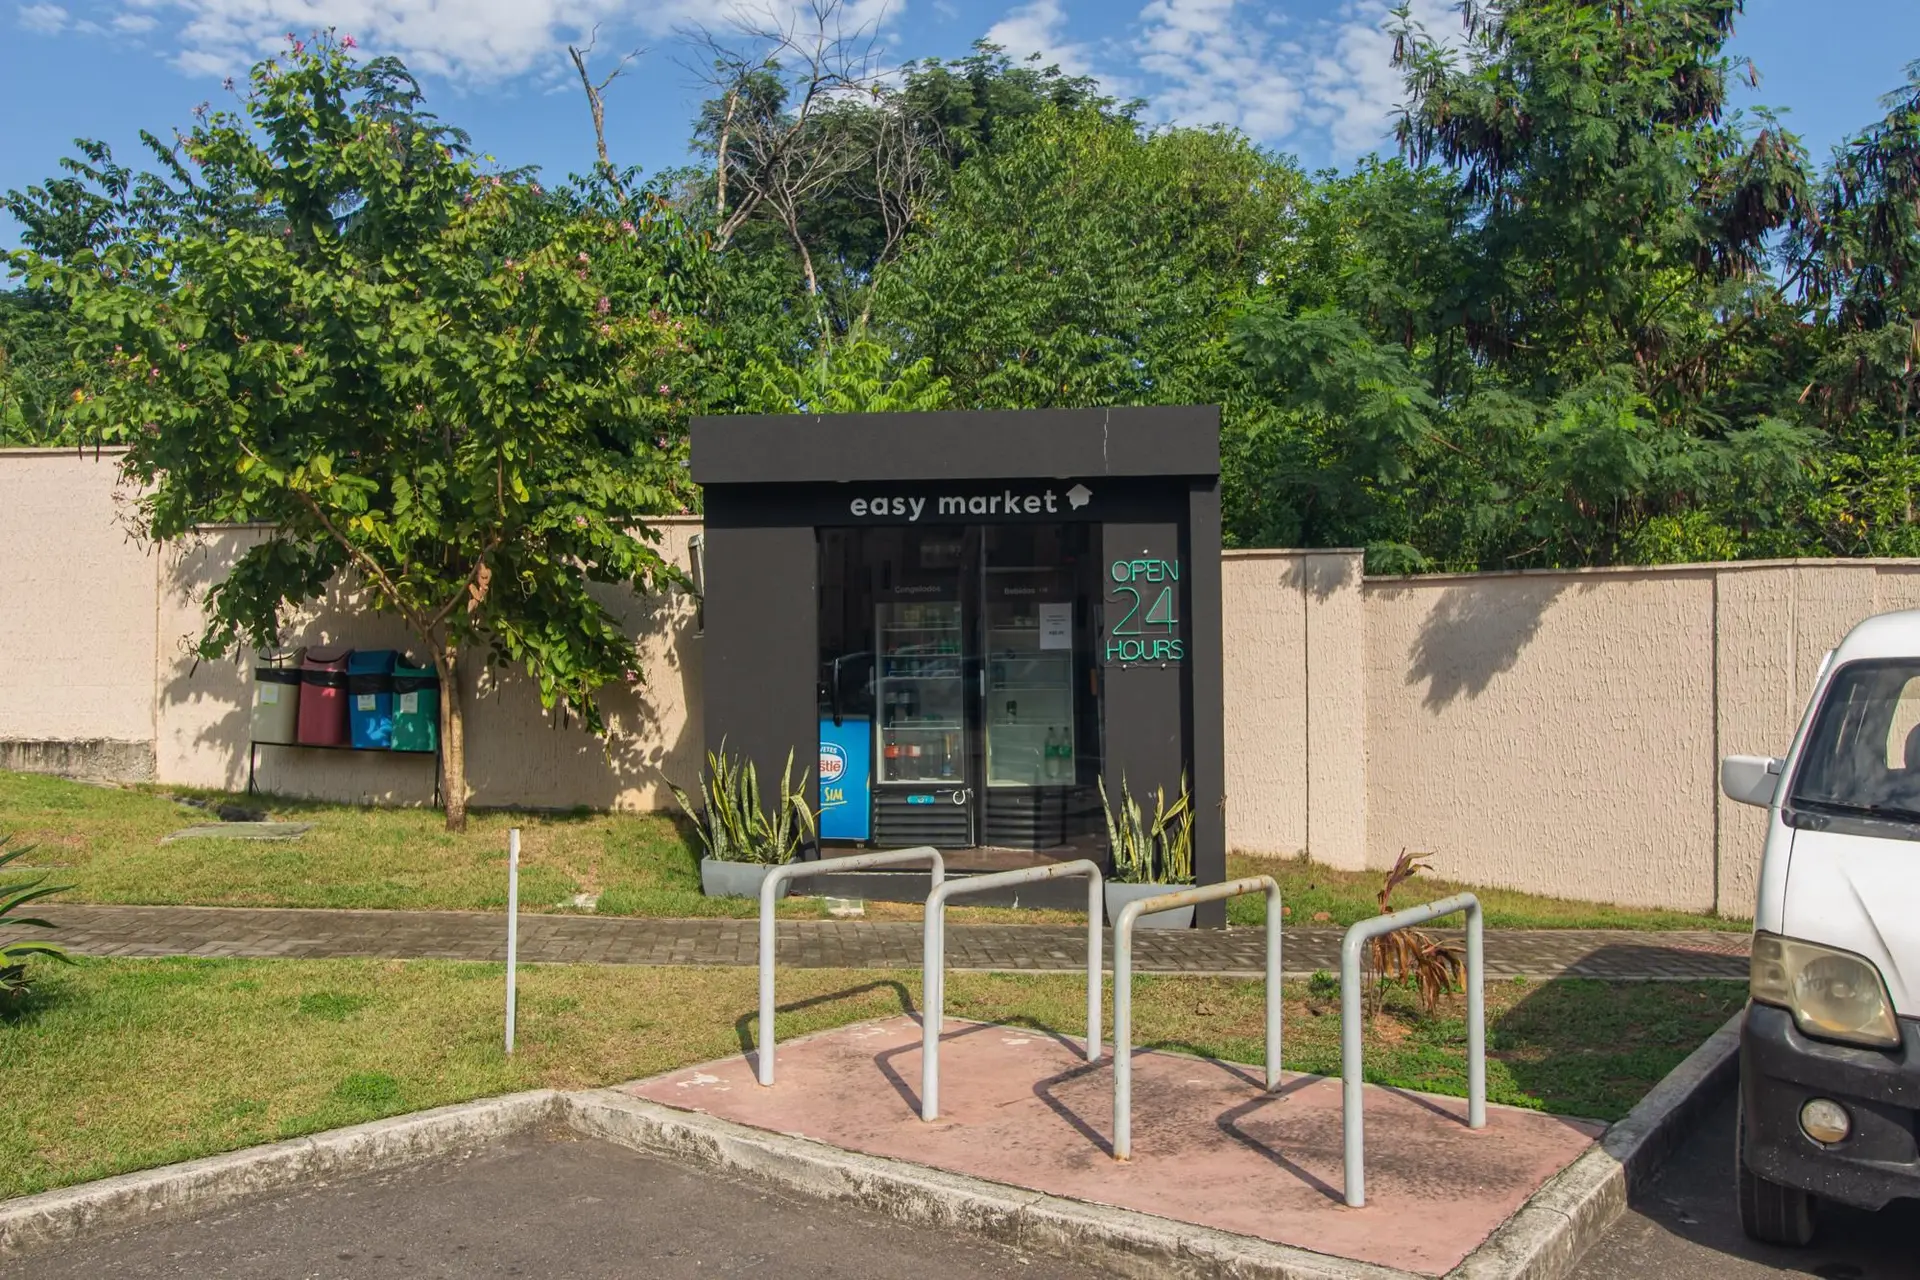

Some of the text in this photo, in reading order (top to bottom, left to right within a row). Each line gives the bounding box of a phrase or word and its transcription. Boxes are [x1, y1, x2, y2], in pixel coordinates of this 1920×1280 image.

[850, 489, 1058, 521] easy market
[1111, 559, 1179, 582] OPEN
[1004, 586, 1036, 595] Bebidas
[1112, 586, 1178, 635] 24
[1106, 639, 1184, 661] HOURS
[825, 786, 843, 801] SIM
